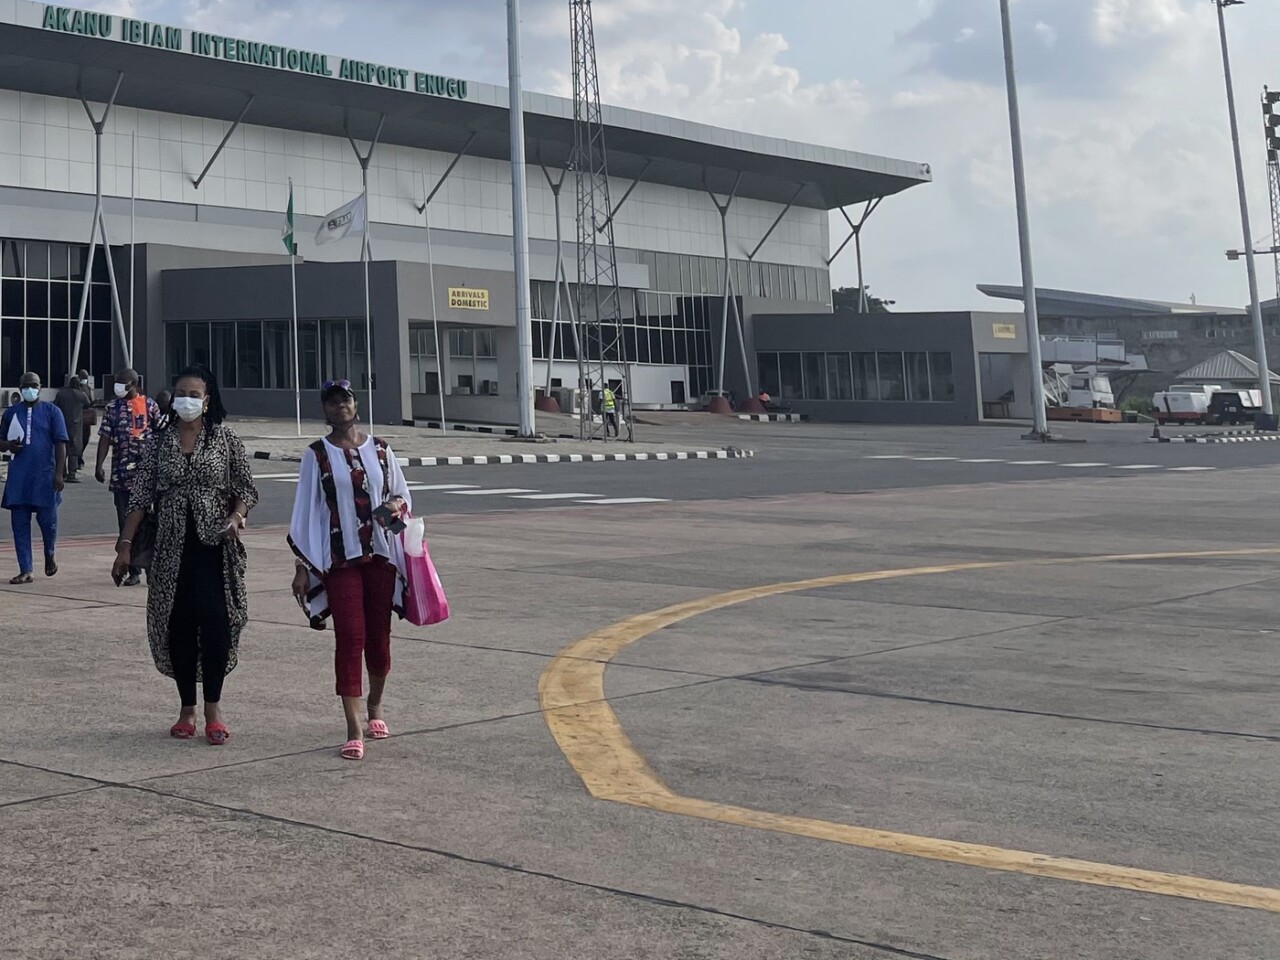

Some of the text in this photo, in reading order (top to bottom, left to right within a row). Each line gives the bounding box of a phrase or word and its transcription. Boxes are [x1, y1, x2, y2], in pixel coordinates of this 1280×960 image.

[42, 5, 468, 99] AKANU IBIAM INTERNATIONAL AIRPORT ENUGU
[451, 290, 485, 298] ARRIVALS
[451, 299, 487, 308] DOMESTIC
